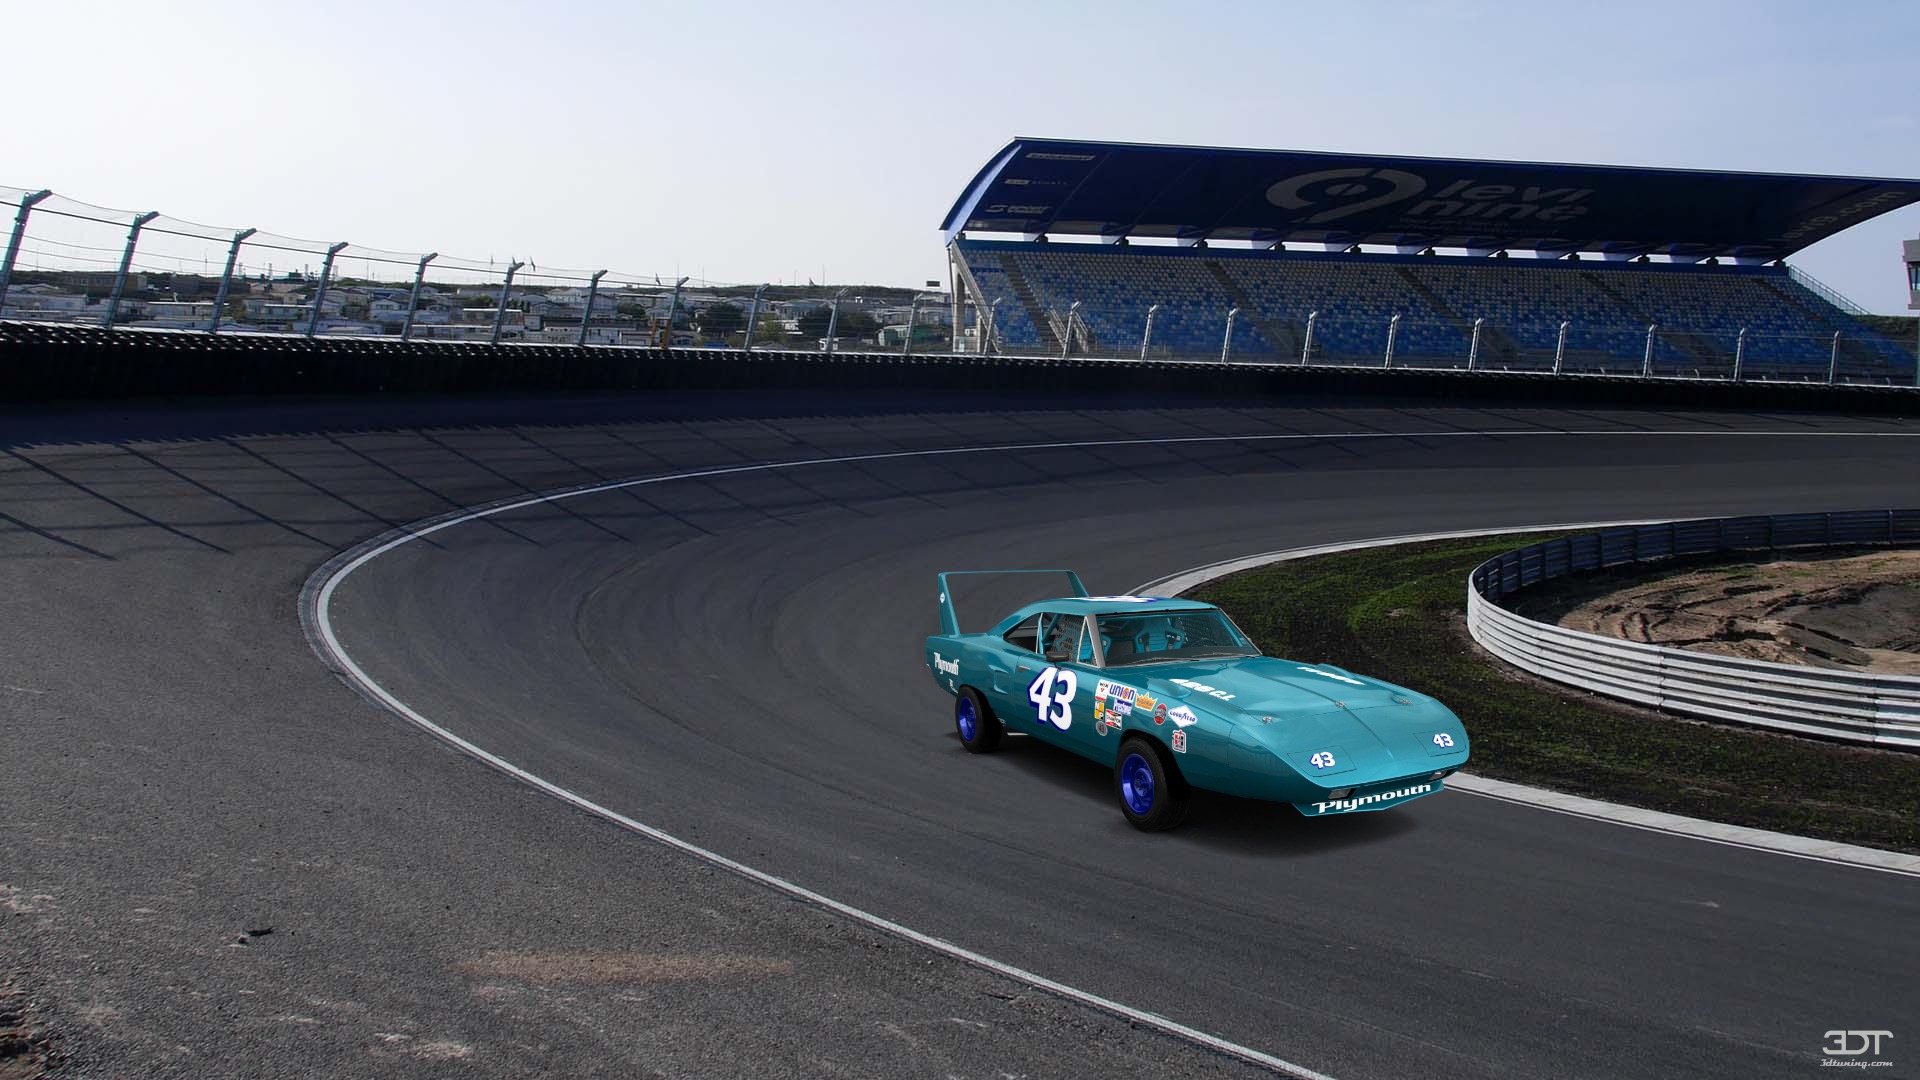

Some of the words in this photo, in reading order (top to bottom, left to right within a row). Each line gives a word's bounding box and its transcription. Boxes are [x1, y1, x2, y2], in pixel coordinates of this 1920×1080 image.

[1027, 666, 1078, 732] 43
[1432, 733, 1454, 748] 43
[1309, 751, 1336, 770] 43
[1311, 784, 1432, 814] Plymouth
